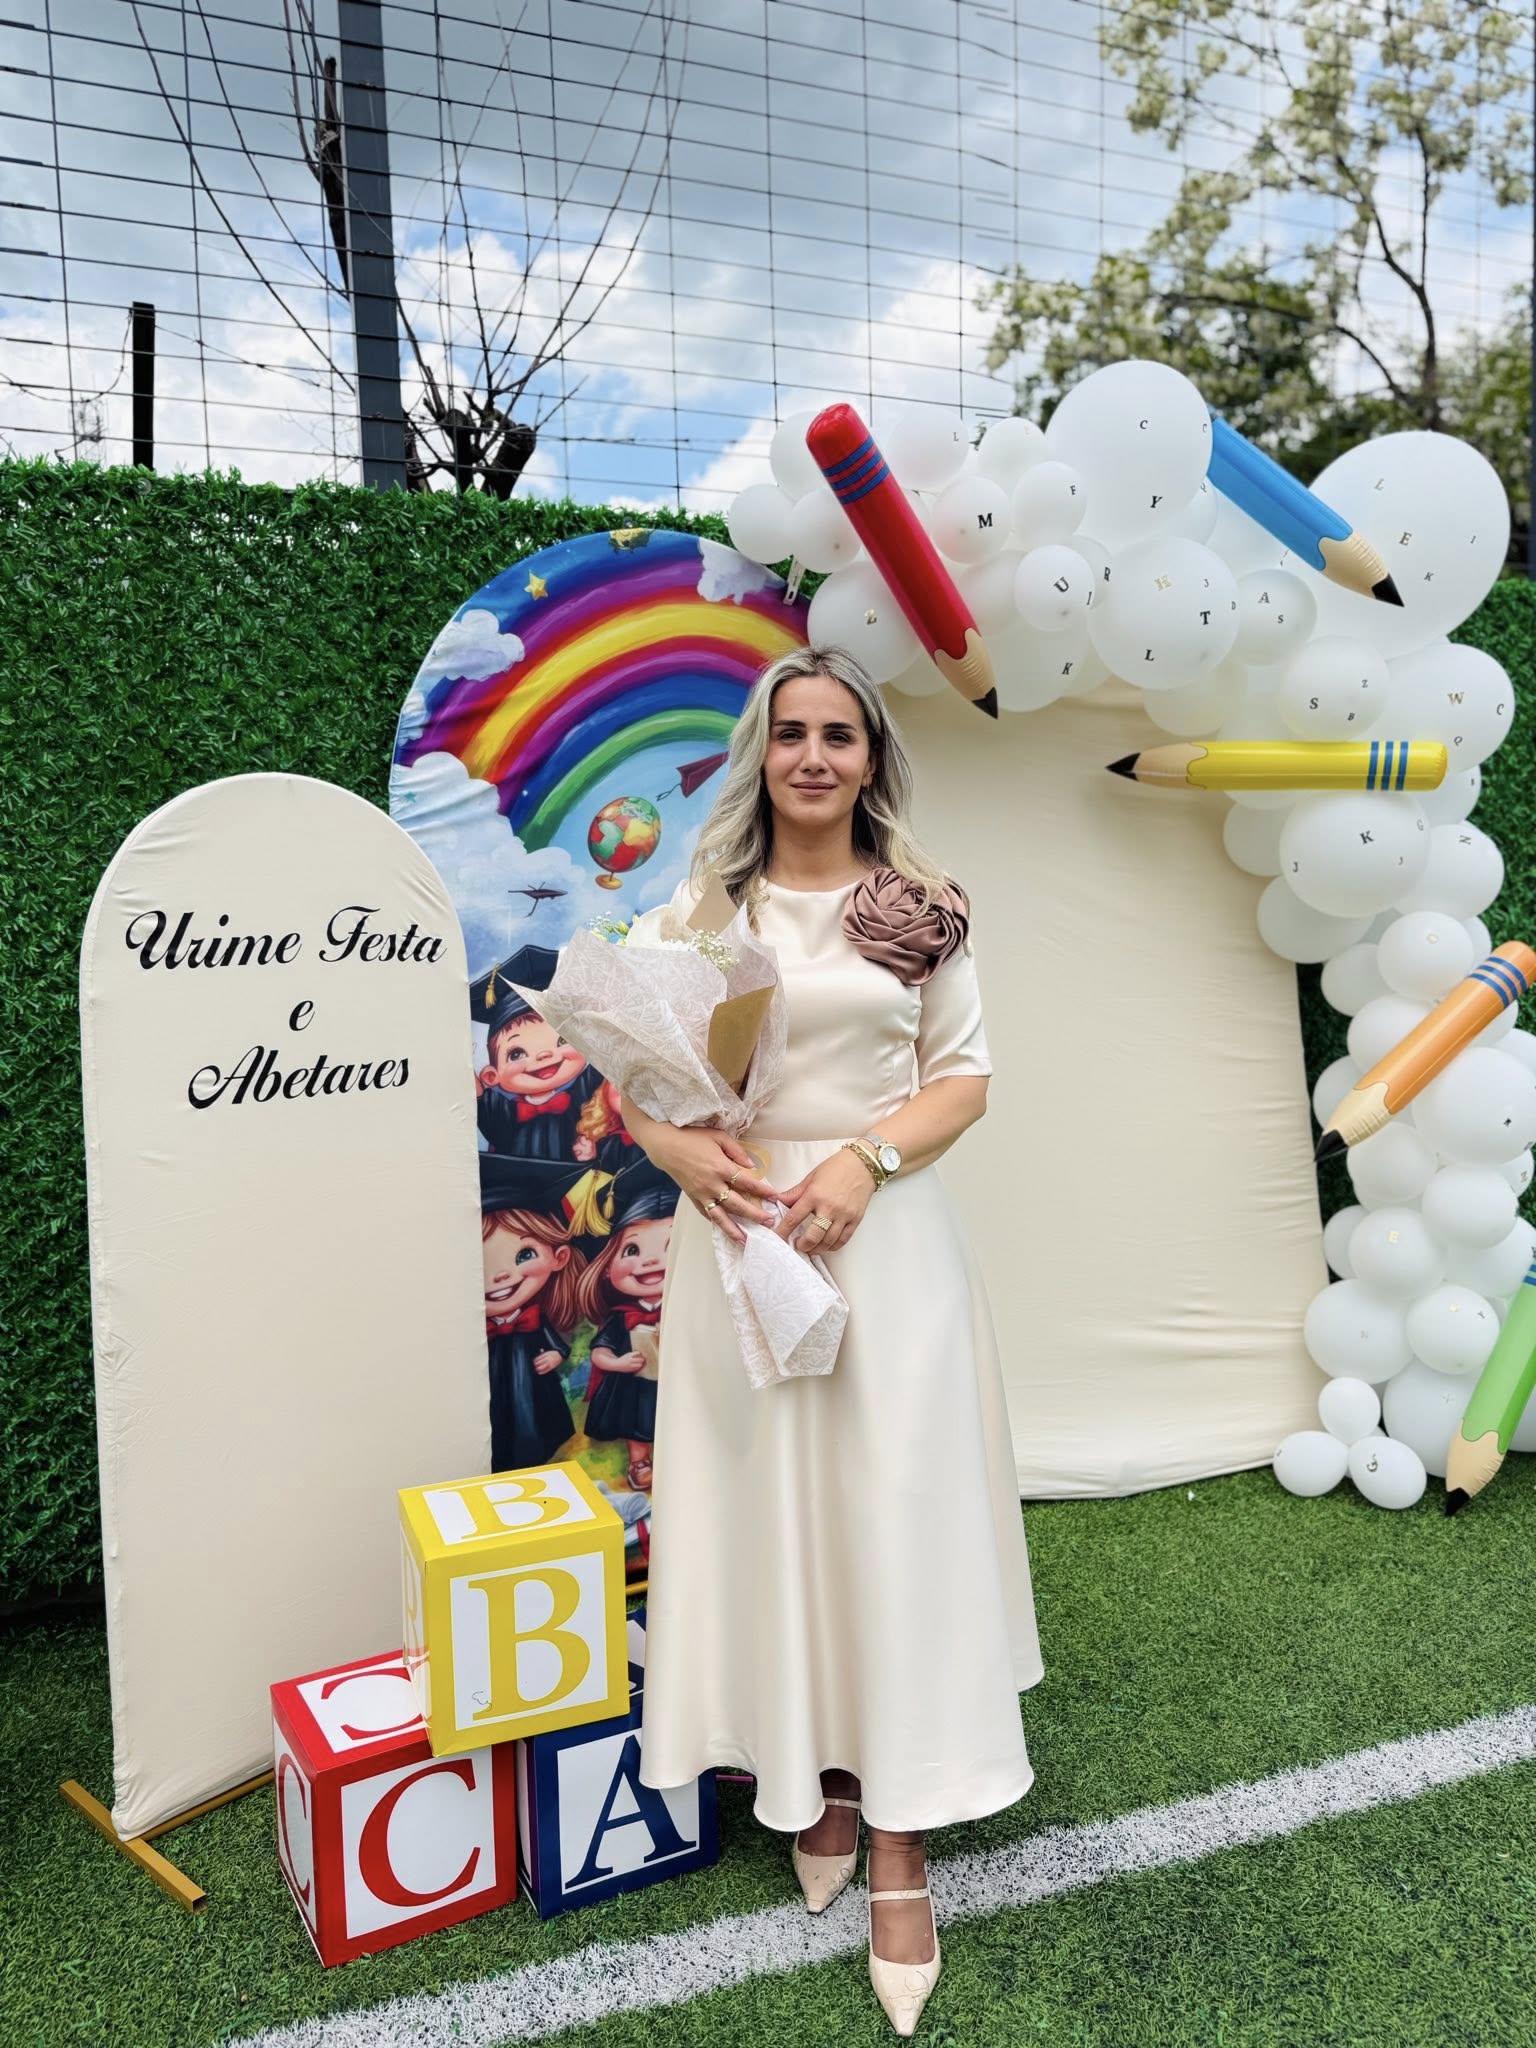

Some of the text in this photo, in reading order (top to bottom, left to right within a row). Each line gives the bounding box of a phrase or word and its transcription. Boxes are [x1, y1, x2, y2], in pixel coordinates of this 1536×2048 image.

[1139, 419, 1149, 430] C
[1150, 495, 1163, 509] Y
[978, 512, 993, 528] M
[1399, 531, 1413, 546] E
[1103, 566, 1111, 582] R
[1053, 576, 1070, 593] U
[1258, 591, 1270, 604] A
[1199, 610, 1211, 626] T
[1144, 649, 1155, 662] L
[1061, 662, 1073, 676] K
[1309, 697, 1319, 710] S
[1447, 692, 1464, 706] W
[1496, 703, 1504, 716] C
[1359, 830, 1374, 845] K
[125, 905, 447, 970] Urime Festa
[288, 1000, 316, 1032] e
[187, 1045, 410, 1110] Abetares
[441, 1477, 572, 1540] B
[467, 1566, 592, 1722] B
[564, 1733, 697, 1891] A
[357, 1757, 481, 1908] C
